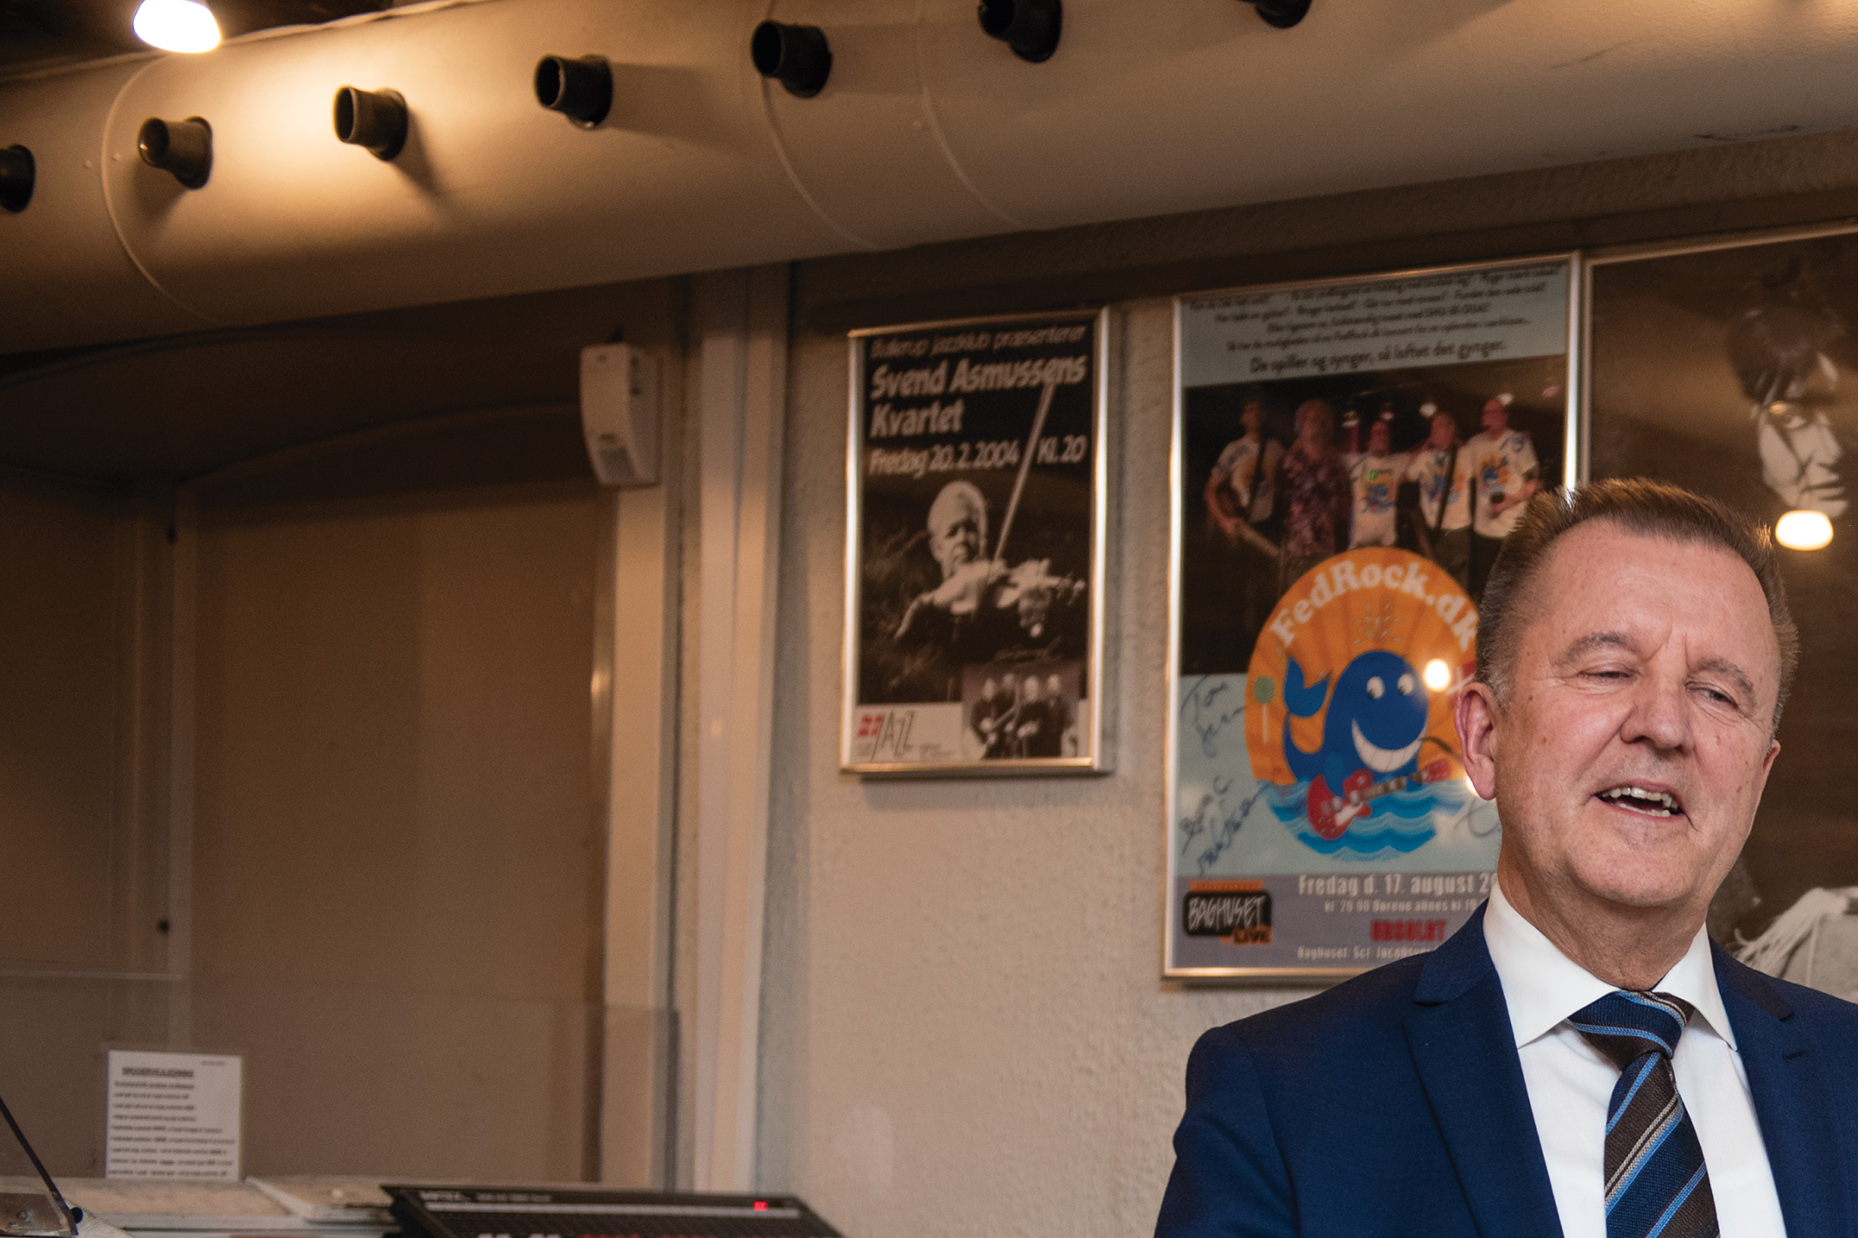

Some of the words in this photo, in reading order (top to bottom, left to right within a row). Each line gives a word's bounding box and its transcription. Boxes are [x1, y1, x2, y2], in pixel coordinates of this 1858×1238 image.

[869, 358, 948, 400] Svend
[948, 354, 1089, 395] Asmussens
[869, 398, 965, 439] Kvartet
[868, 448, 930, 480] Fredag
[1269, 560, 1478, 651] FedRock.dk
[1298, 874, 1359, 896] Fredag
[1410, 873, 1475, 896] august
[1188, 895, 1267, 931] BAGHUSET
[1234, 926, 1272, 944] LIVE
